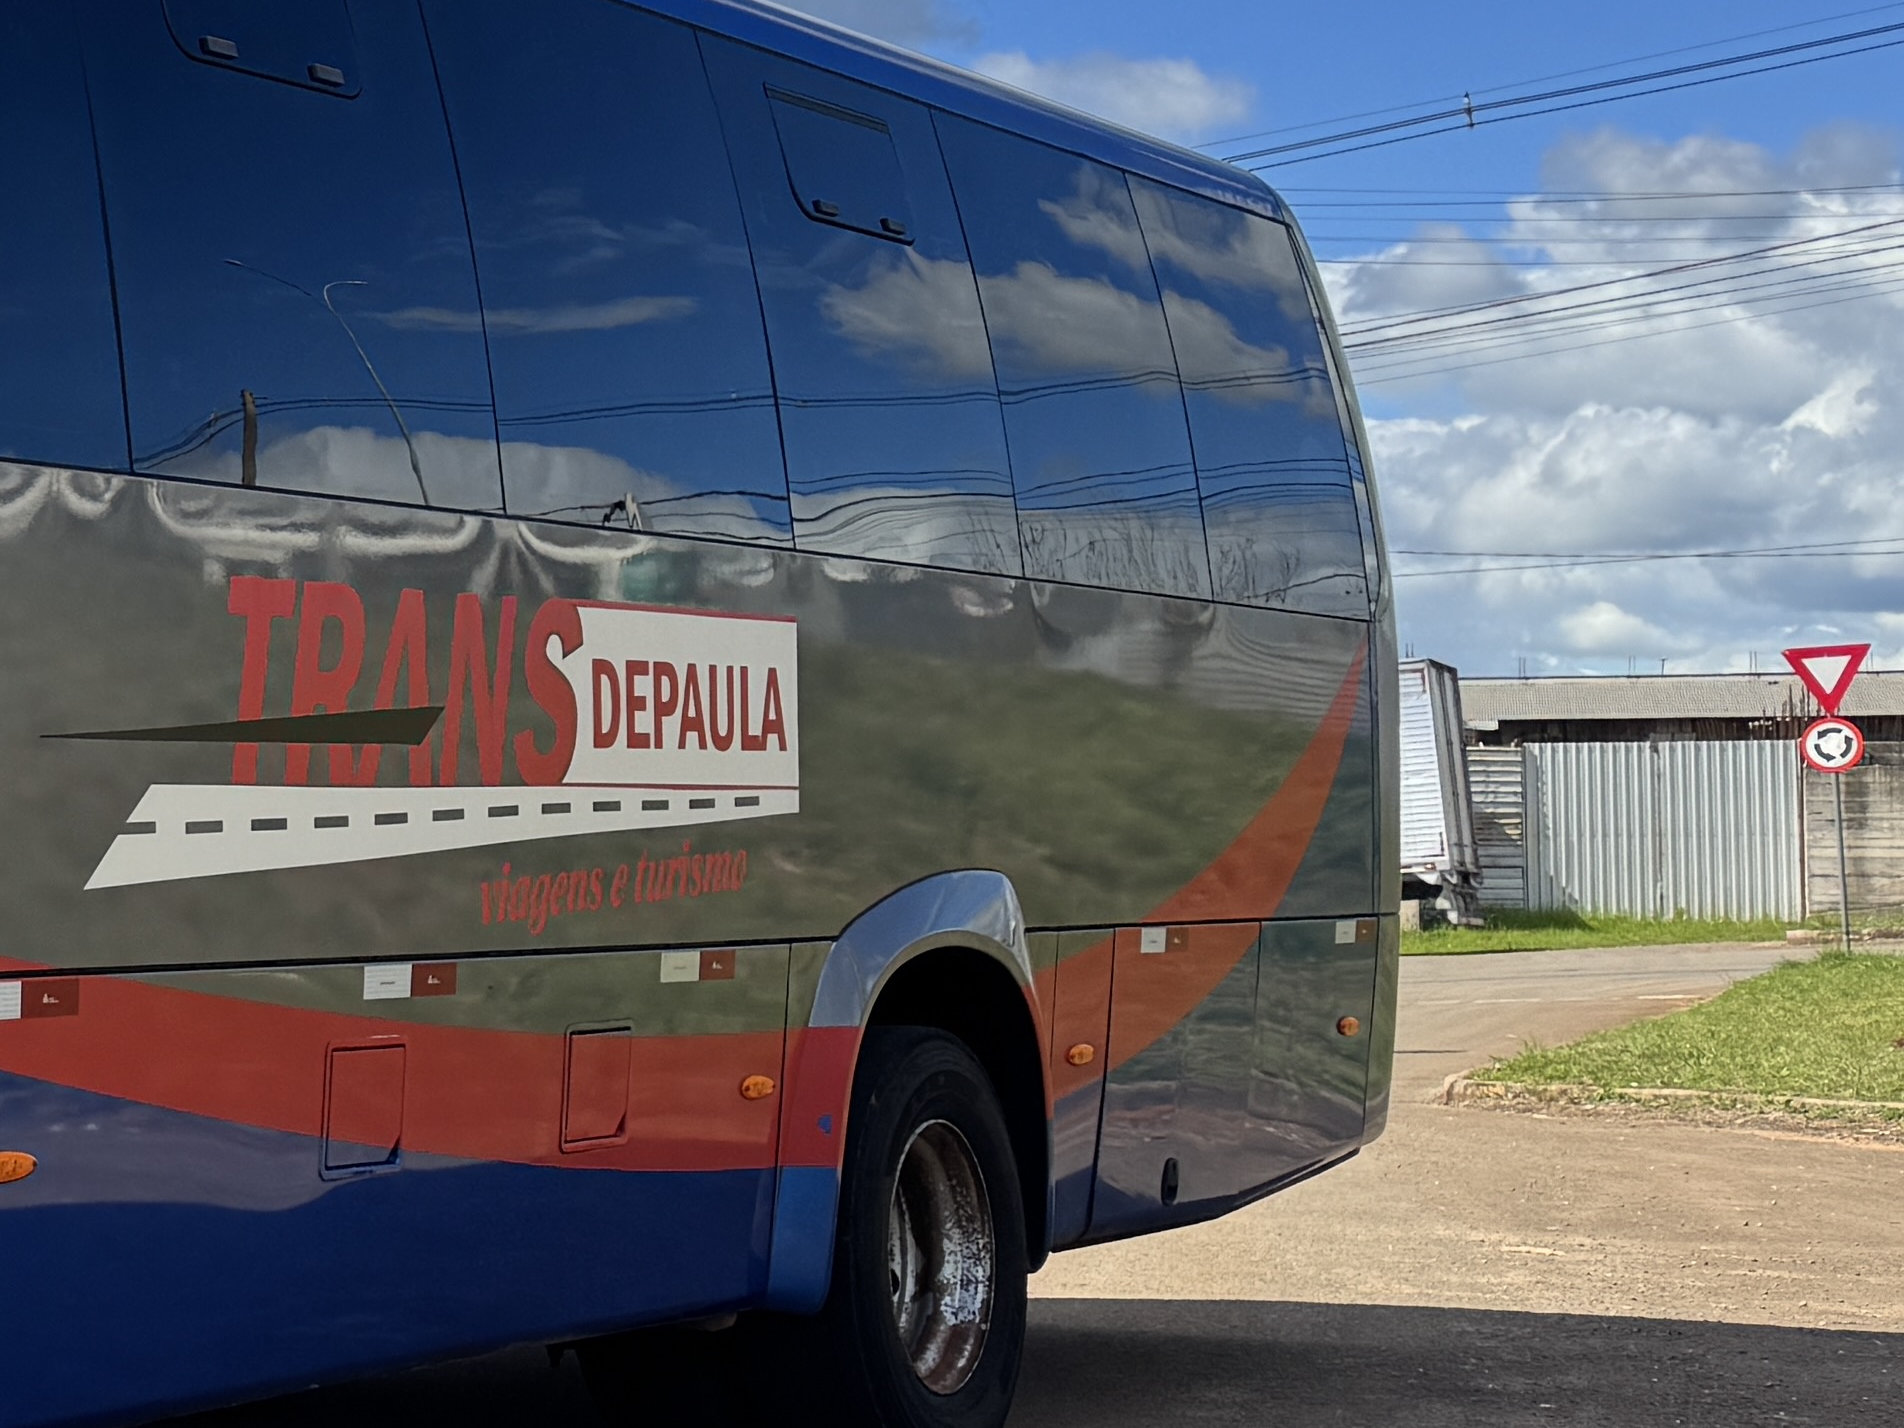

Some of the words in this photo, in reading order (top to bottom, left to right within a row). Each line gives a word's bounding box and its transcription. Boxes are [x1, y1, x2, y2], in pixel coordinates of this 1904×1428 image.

[227, 575, 584, 786] TRANS
[591, 657, 788, 753] DEPAULA
[480, 861, 604, 936] viagens
[610, 864, 630, 908] e
[633, 838, 748, 904] turismo
